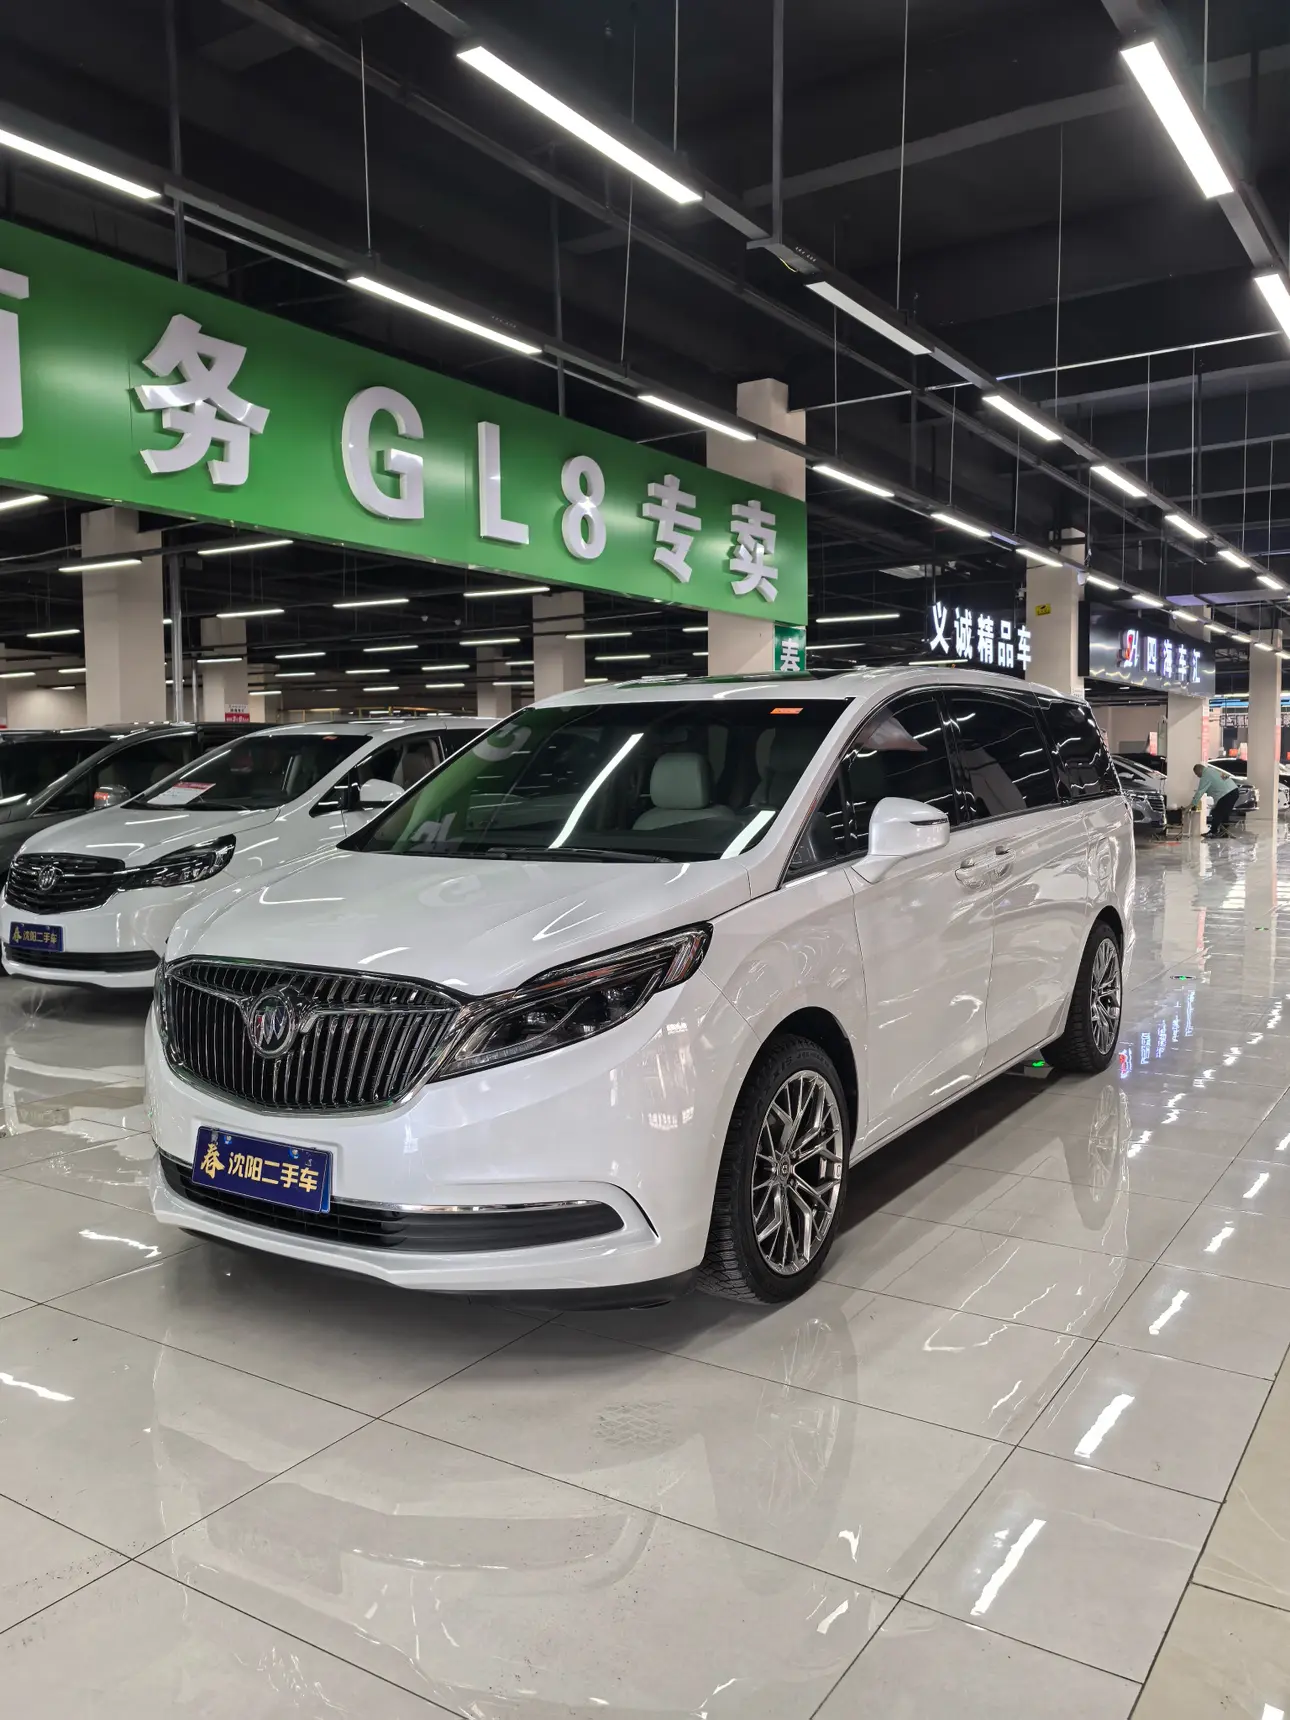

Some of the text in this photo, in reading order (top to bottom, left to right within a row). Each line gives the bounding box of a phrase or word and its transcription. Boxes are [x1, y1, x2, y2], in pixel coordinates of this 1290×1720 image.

[929, 600, 1032, 671] 义诚精品车
[227, 1151, 319, 1193] 沈阳二手车
